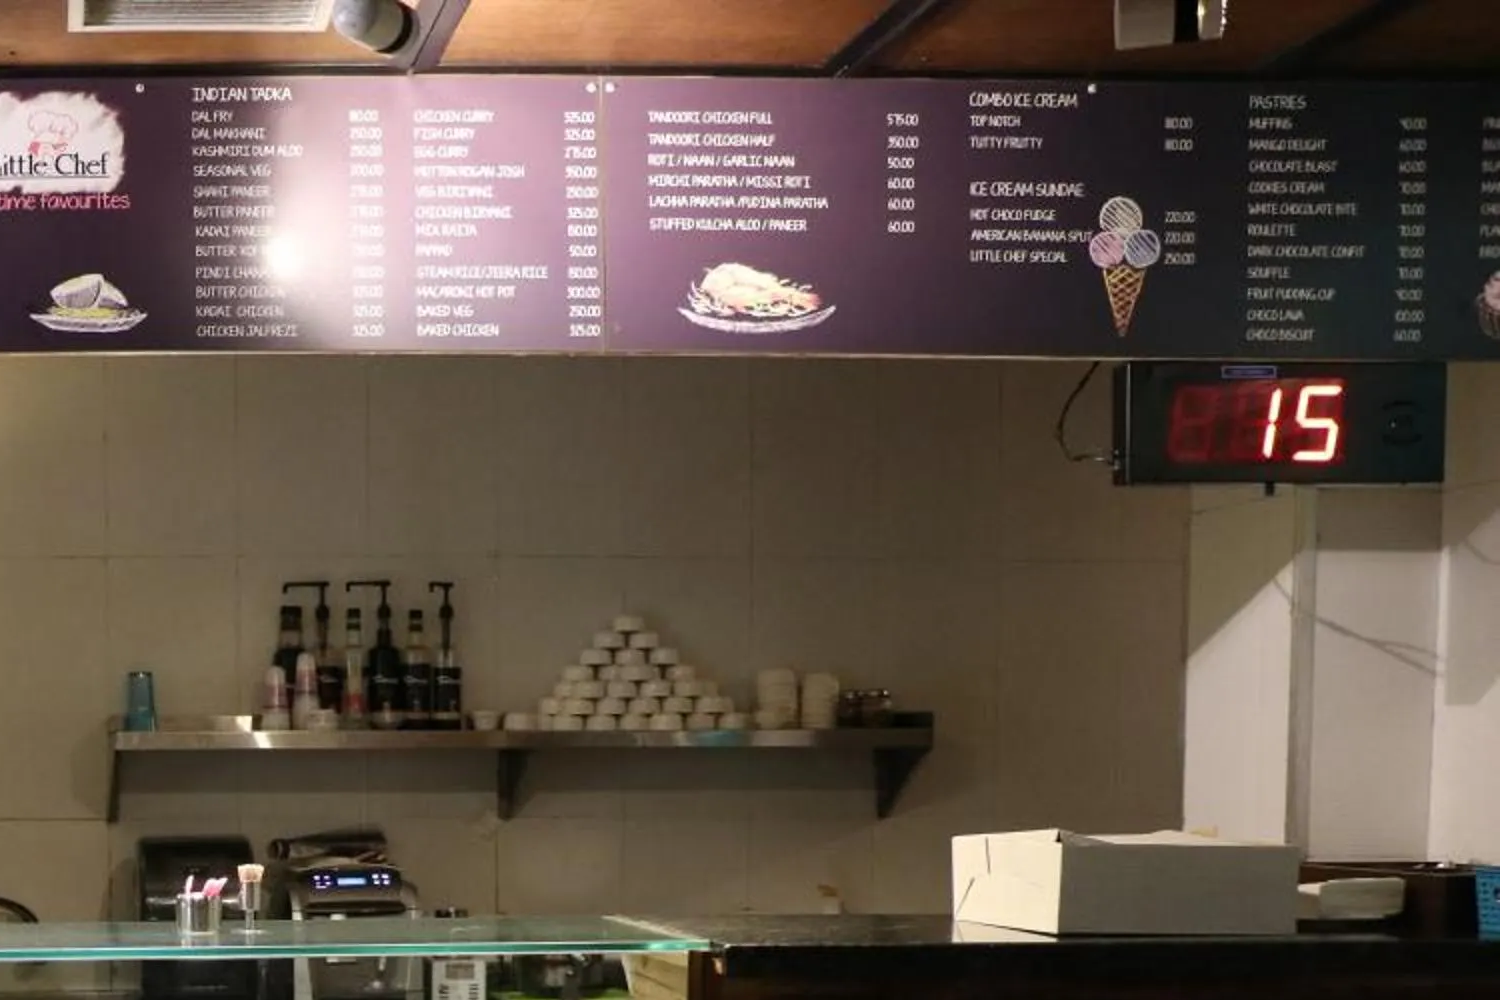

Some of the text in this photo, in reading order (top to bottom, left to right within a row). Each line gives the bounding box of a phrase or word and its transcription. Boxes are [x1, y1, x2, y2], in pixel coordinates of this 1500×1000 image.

[192, 87, 247, 102] INDIAN
[55, 153, 109, 175] Chef
[990, 182, 1035, 197] CREAM
[39, 192, 131, 209] favourites
[1261, 384, 1343, 462] 15
